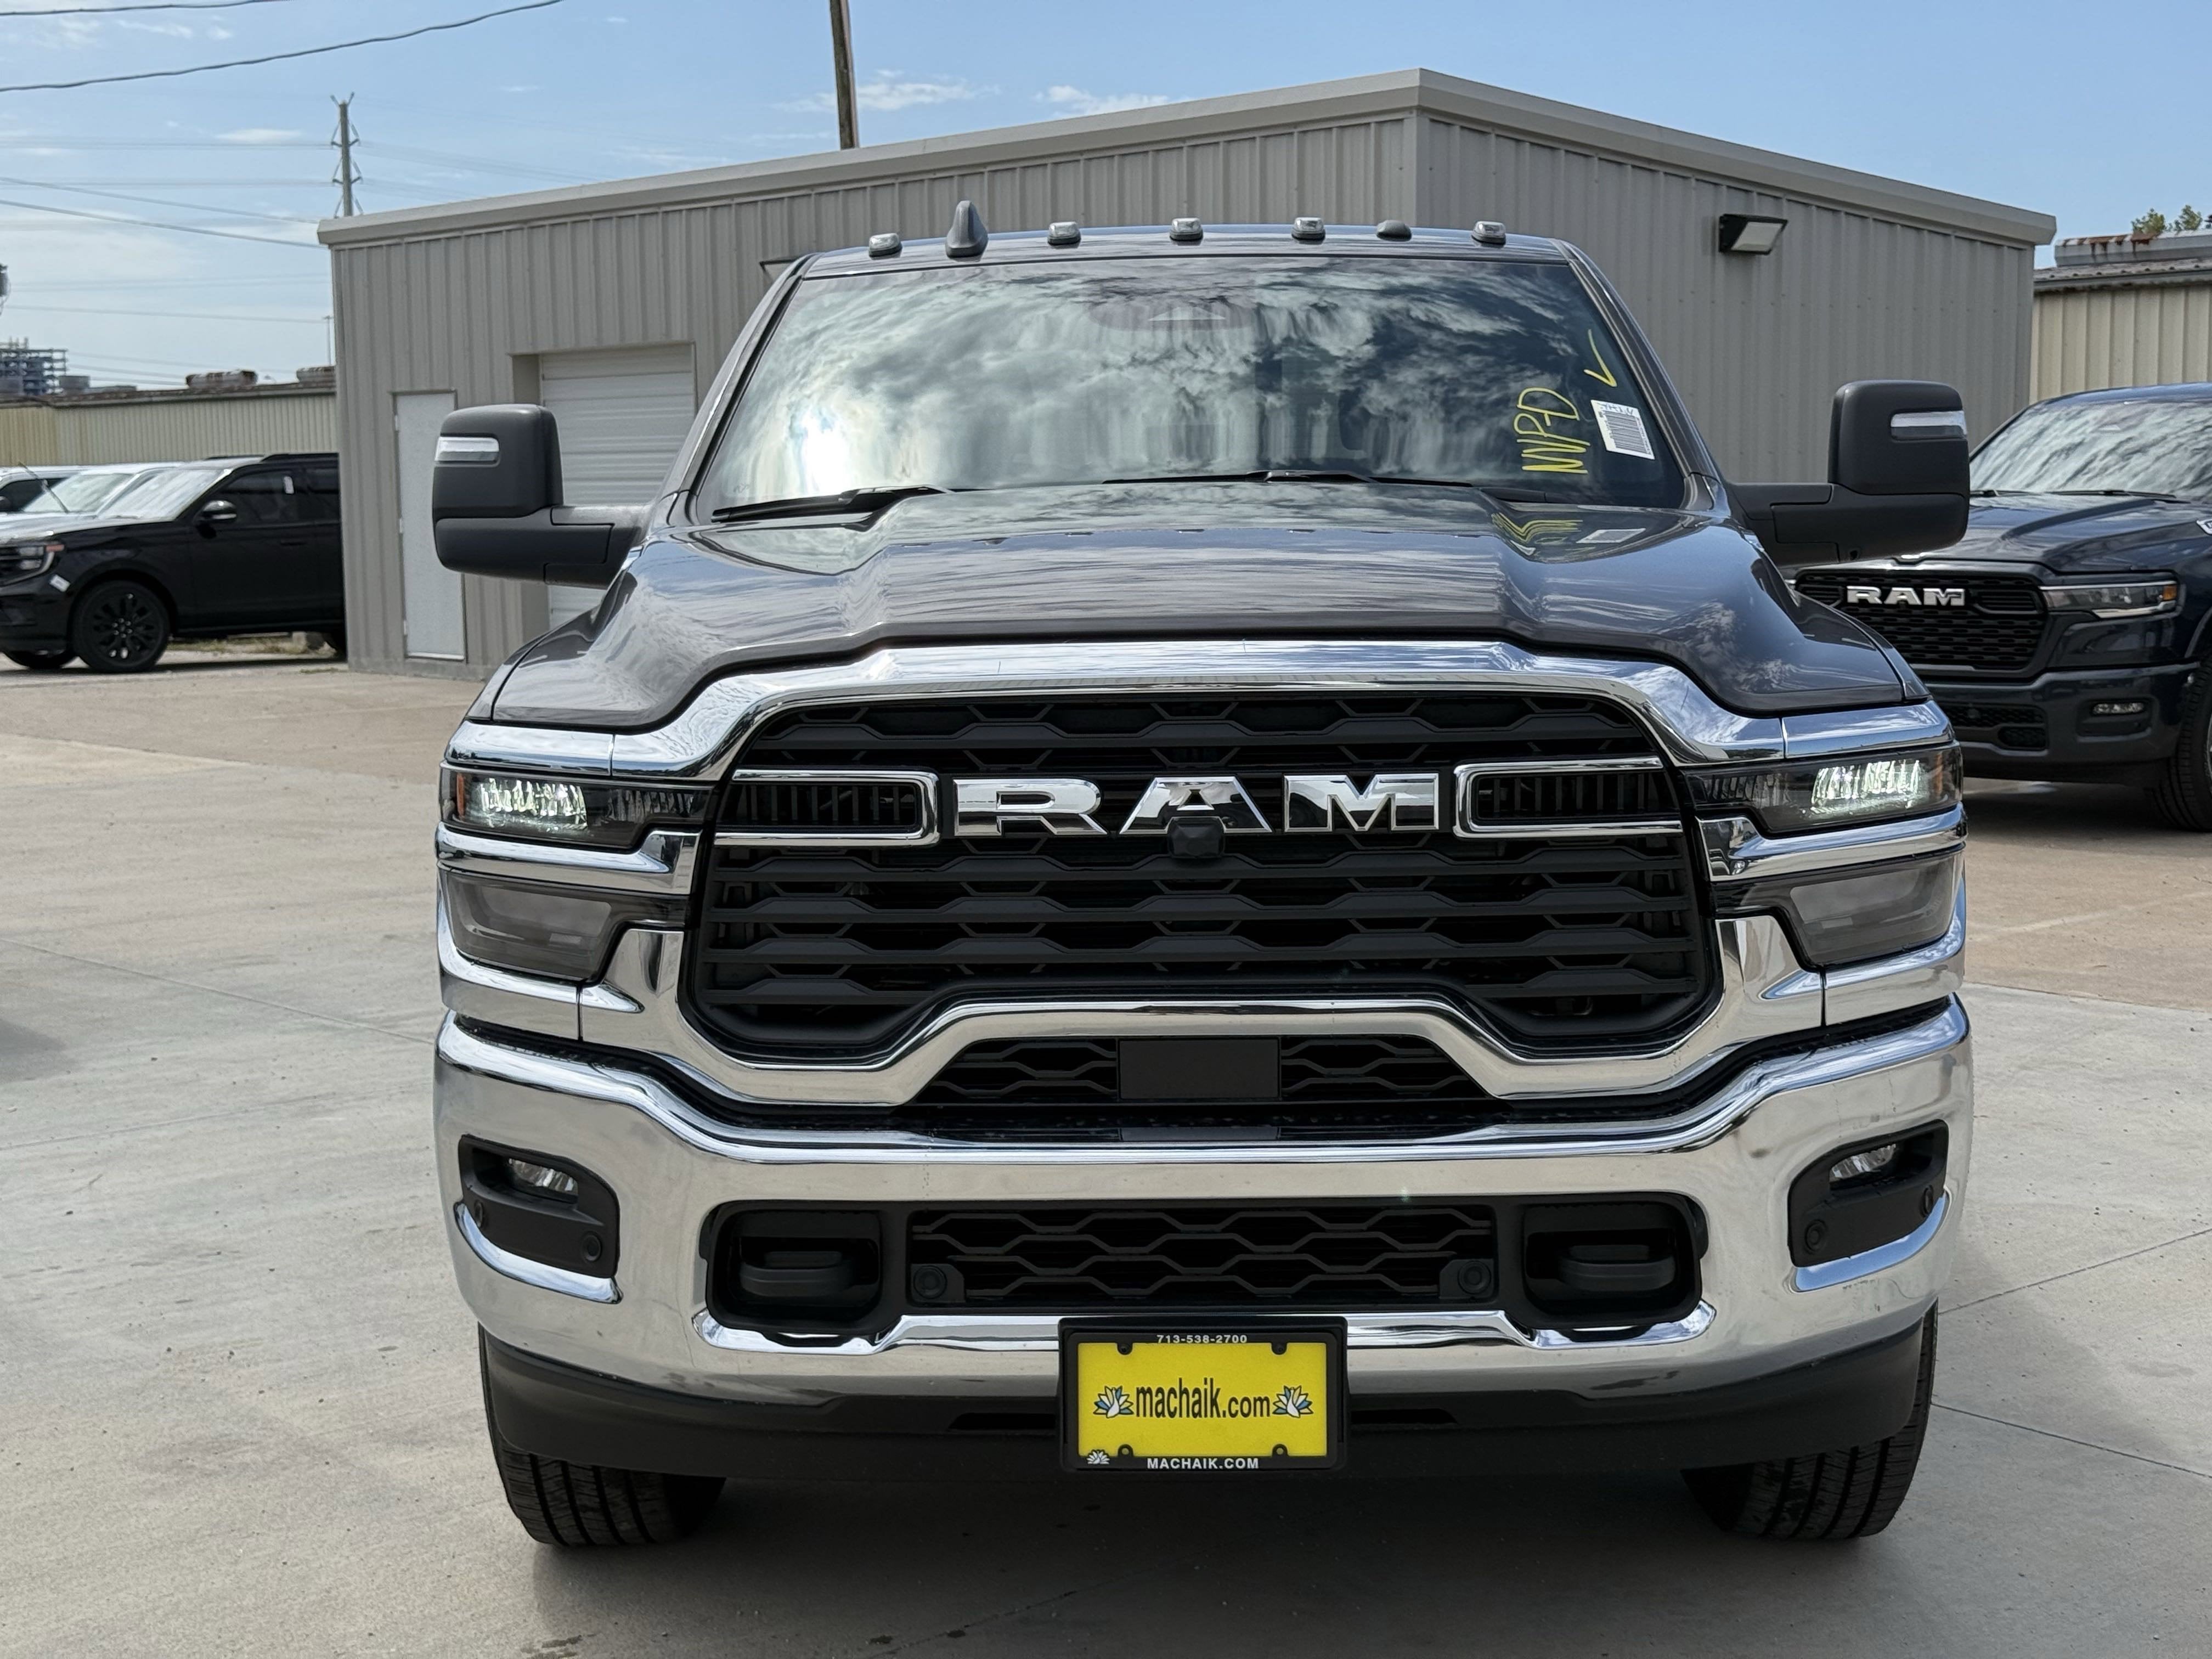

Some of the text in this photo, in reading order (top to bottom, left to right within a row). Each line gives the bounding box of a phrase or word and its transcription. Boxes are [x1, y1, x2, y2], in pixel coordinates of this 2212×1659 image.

[1847, 585, 1965, 606] RAM
[952, 772, 1440, 837] RAM
[1156, 1334, 1248, 1344] 713-538-2700
[1136, 1377, 1271, 1418] machaik.com
[1147, 1458, 1259, 1469] MACHAIK.COM
